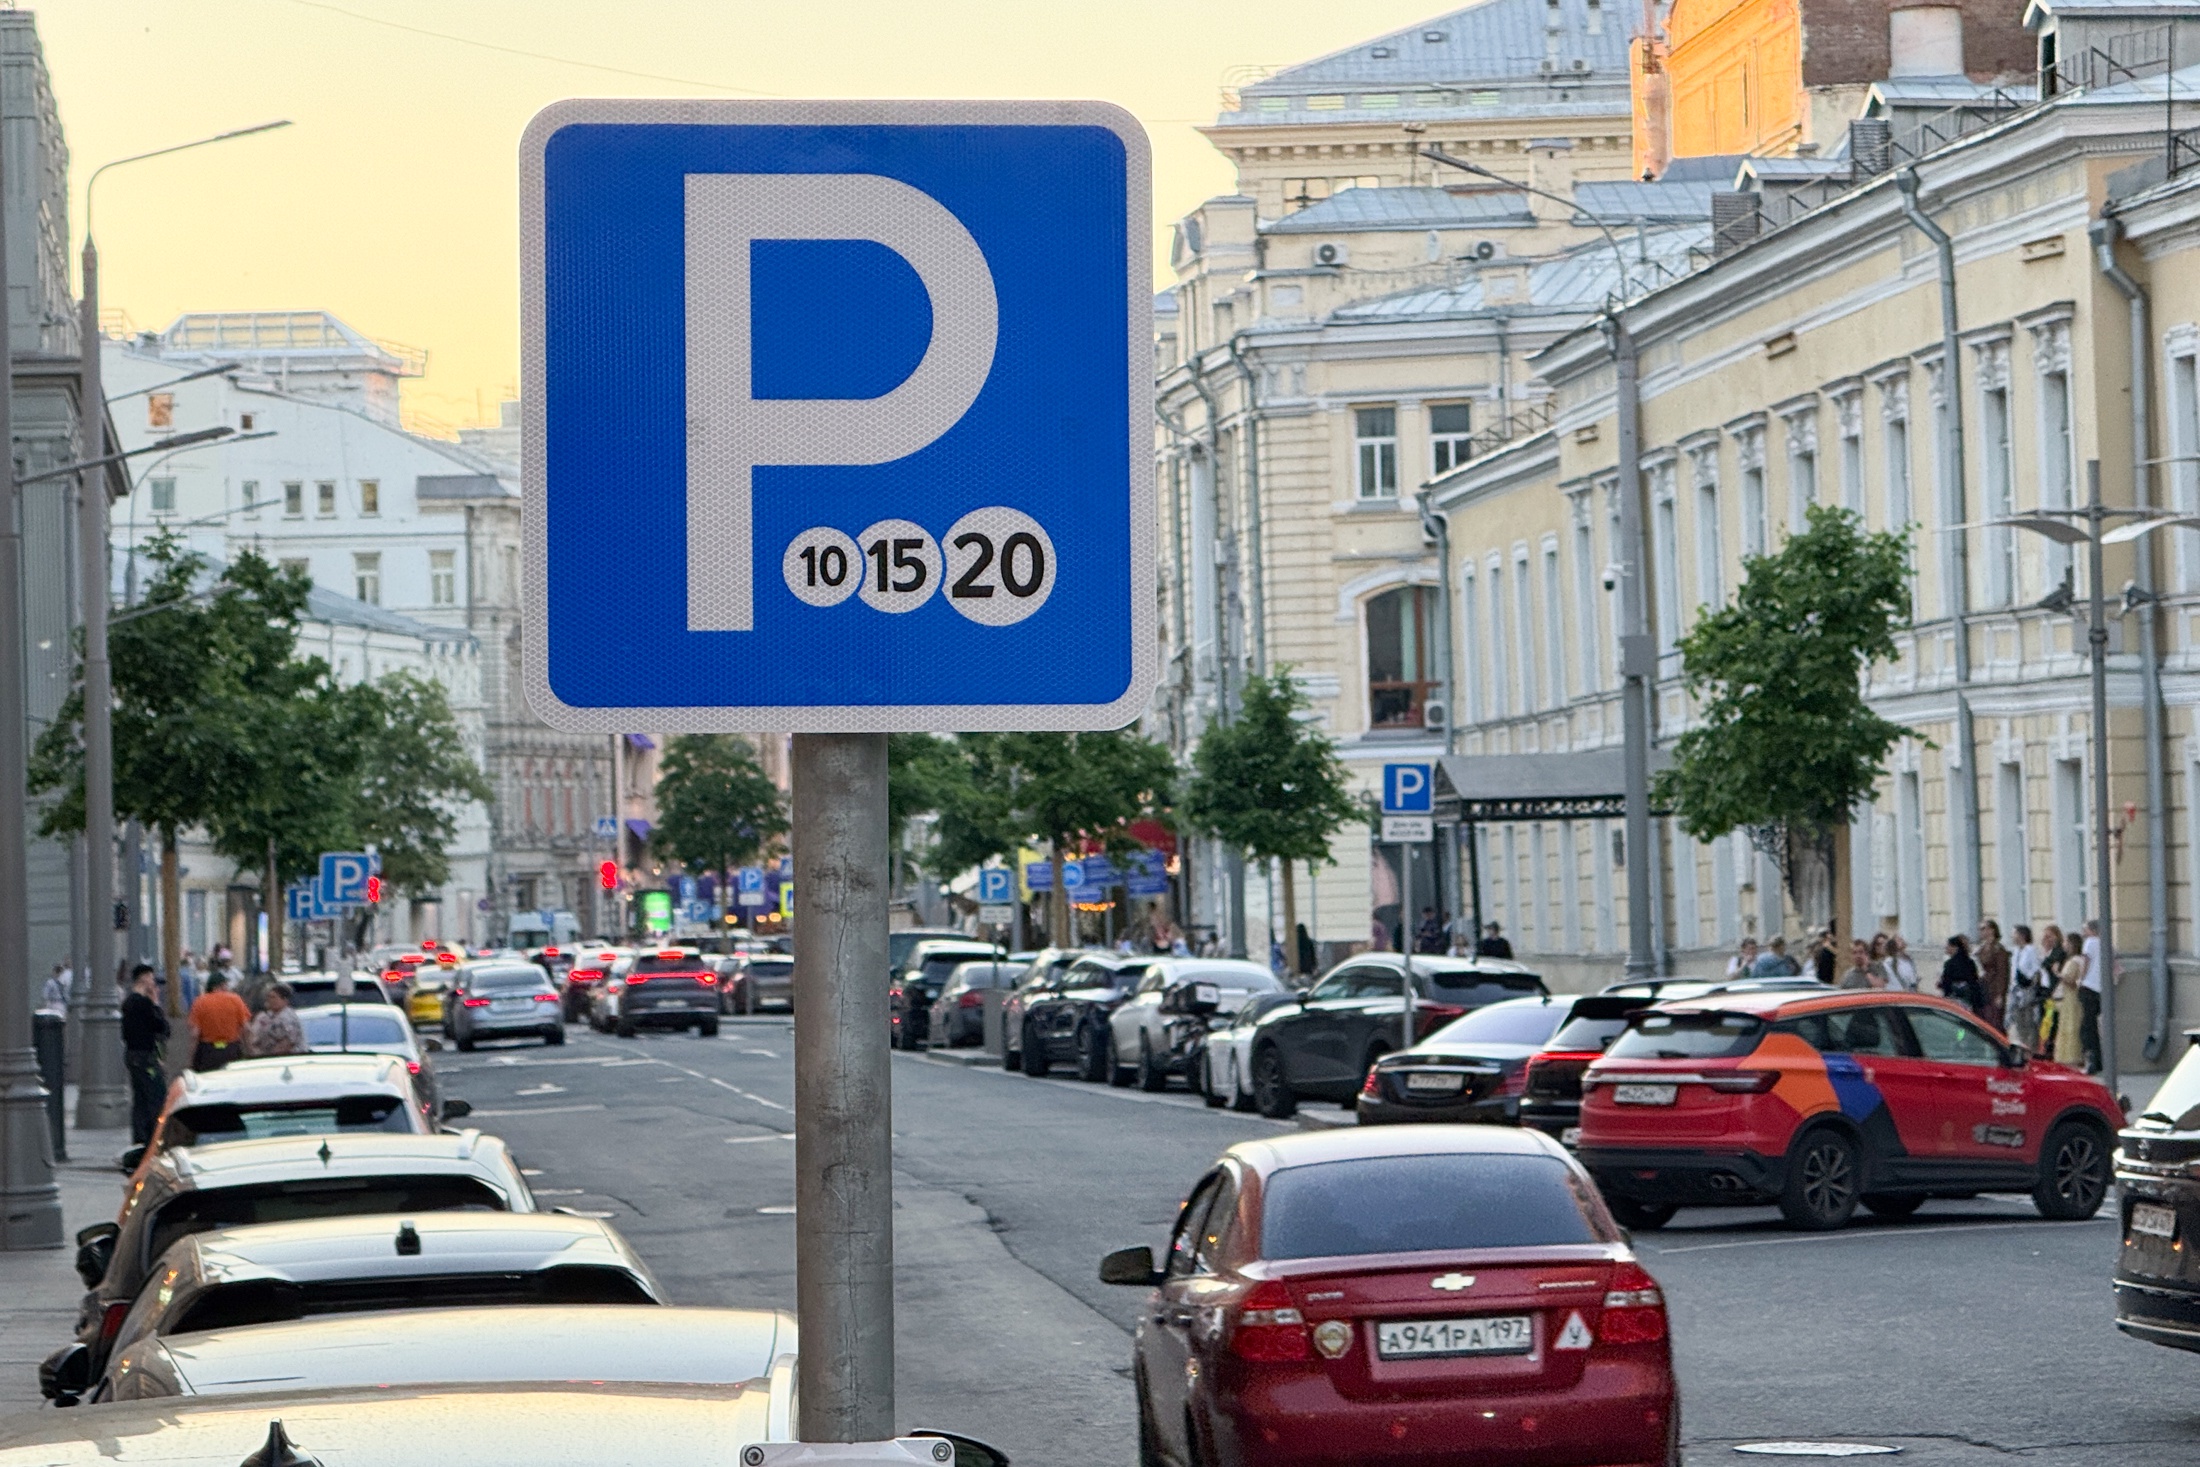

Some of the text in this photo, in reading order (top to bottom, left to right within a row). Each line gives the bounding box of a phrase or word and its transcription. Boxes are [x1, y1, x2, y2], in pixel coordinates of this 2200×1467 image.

[684, 173, 999, 632] P
[799, 531, 1045, 598] 10 15 20
[1395, 767, 1424, 809] P
[334, 859, 362, 899] P
[986, 872, 1006, 899] P
